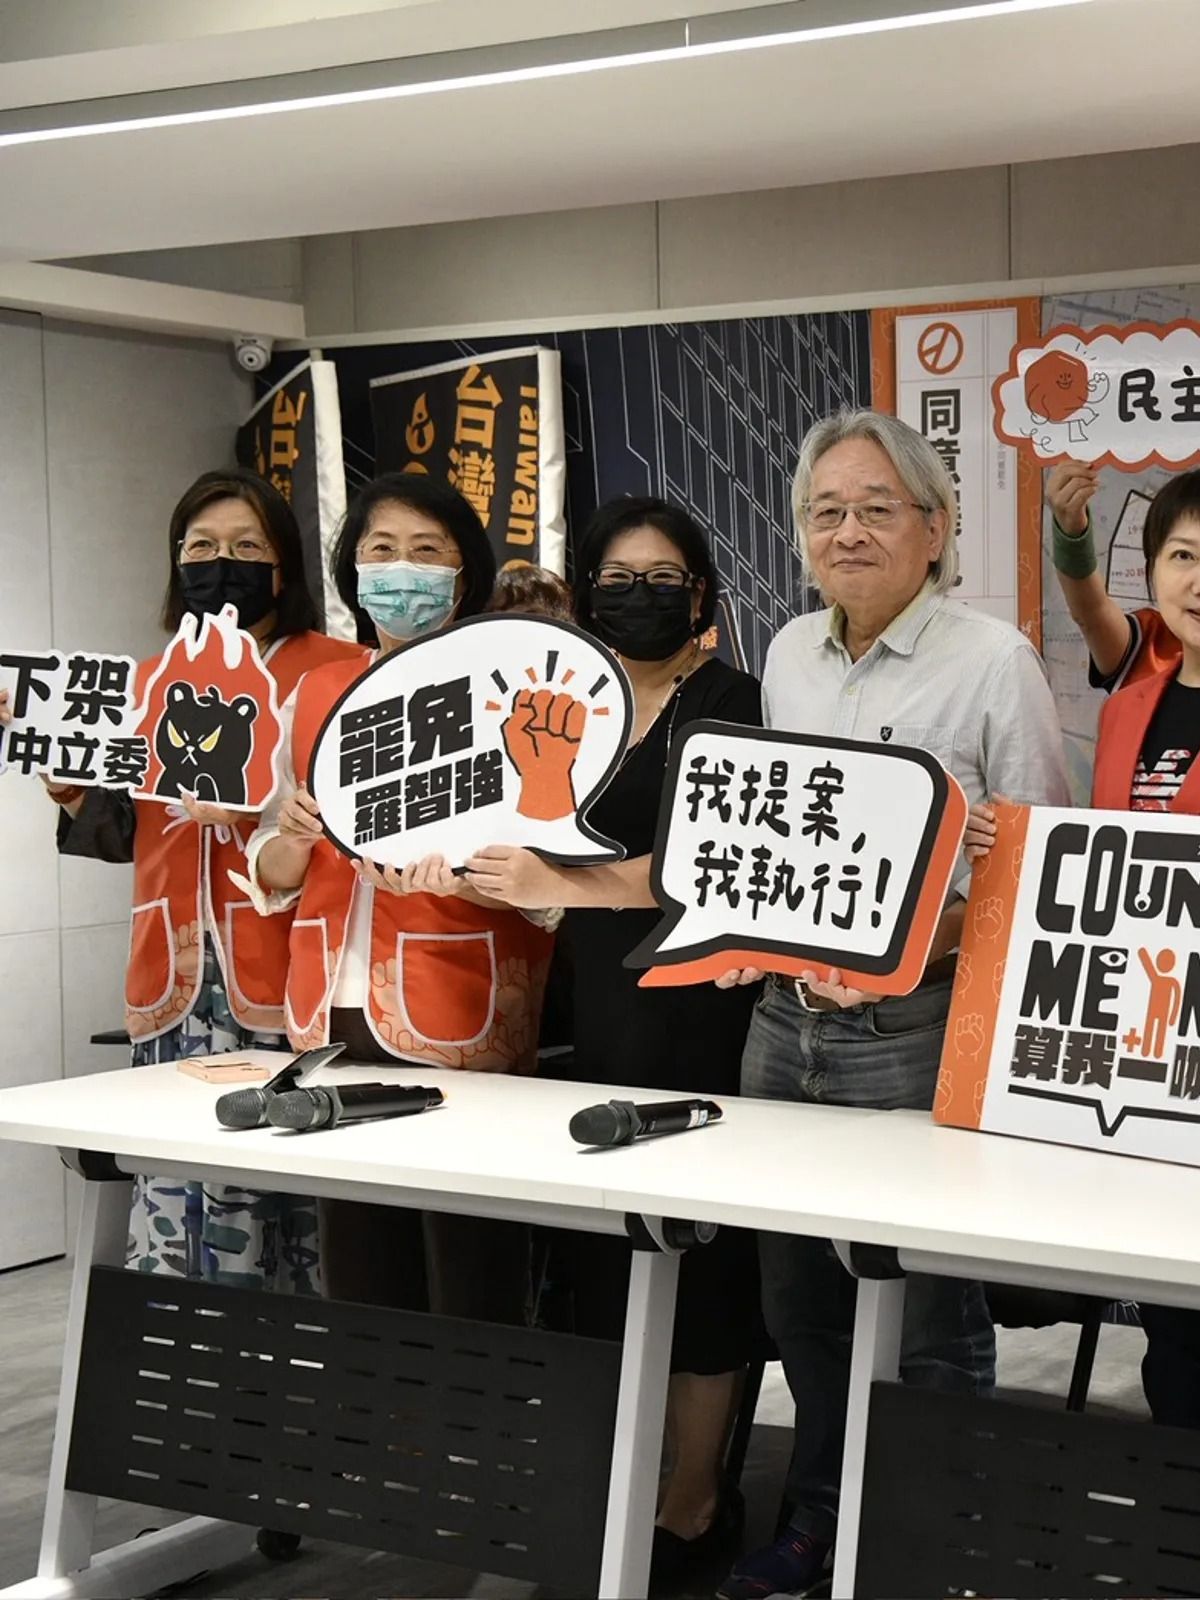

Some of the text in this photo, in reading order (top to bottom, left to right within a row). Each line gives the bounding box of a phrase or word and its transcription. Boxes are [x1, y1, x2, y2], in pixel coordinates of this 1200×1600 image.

[0, 653, 130, 727] 下架
[339, 675, 474, 788] 罷免
[0, 725, 149, 787] 中立委
[353, 748, 504, 847] 羅智強
[693, 840, 892, 930] 我執行!
[1018, 939, 1129, 1031] ME
